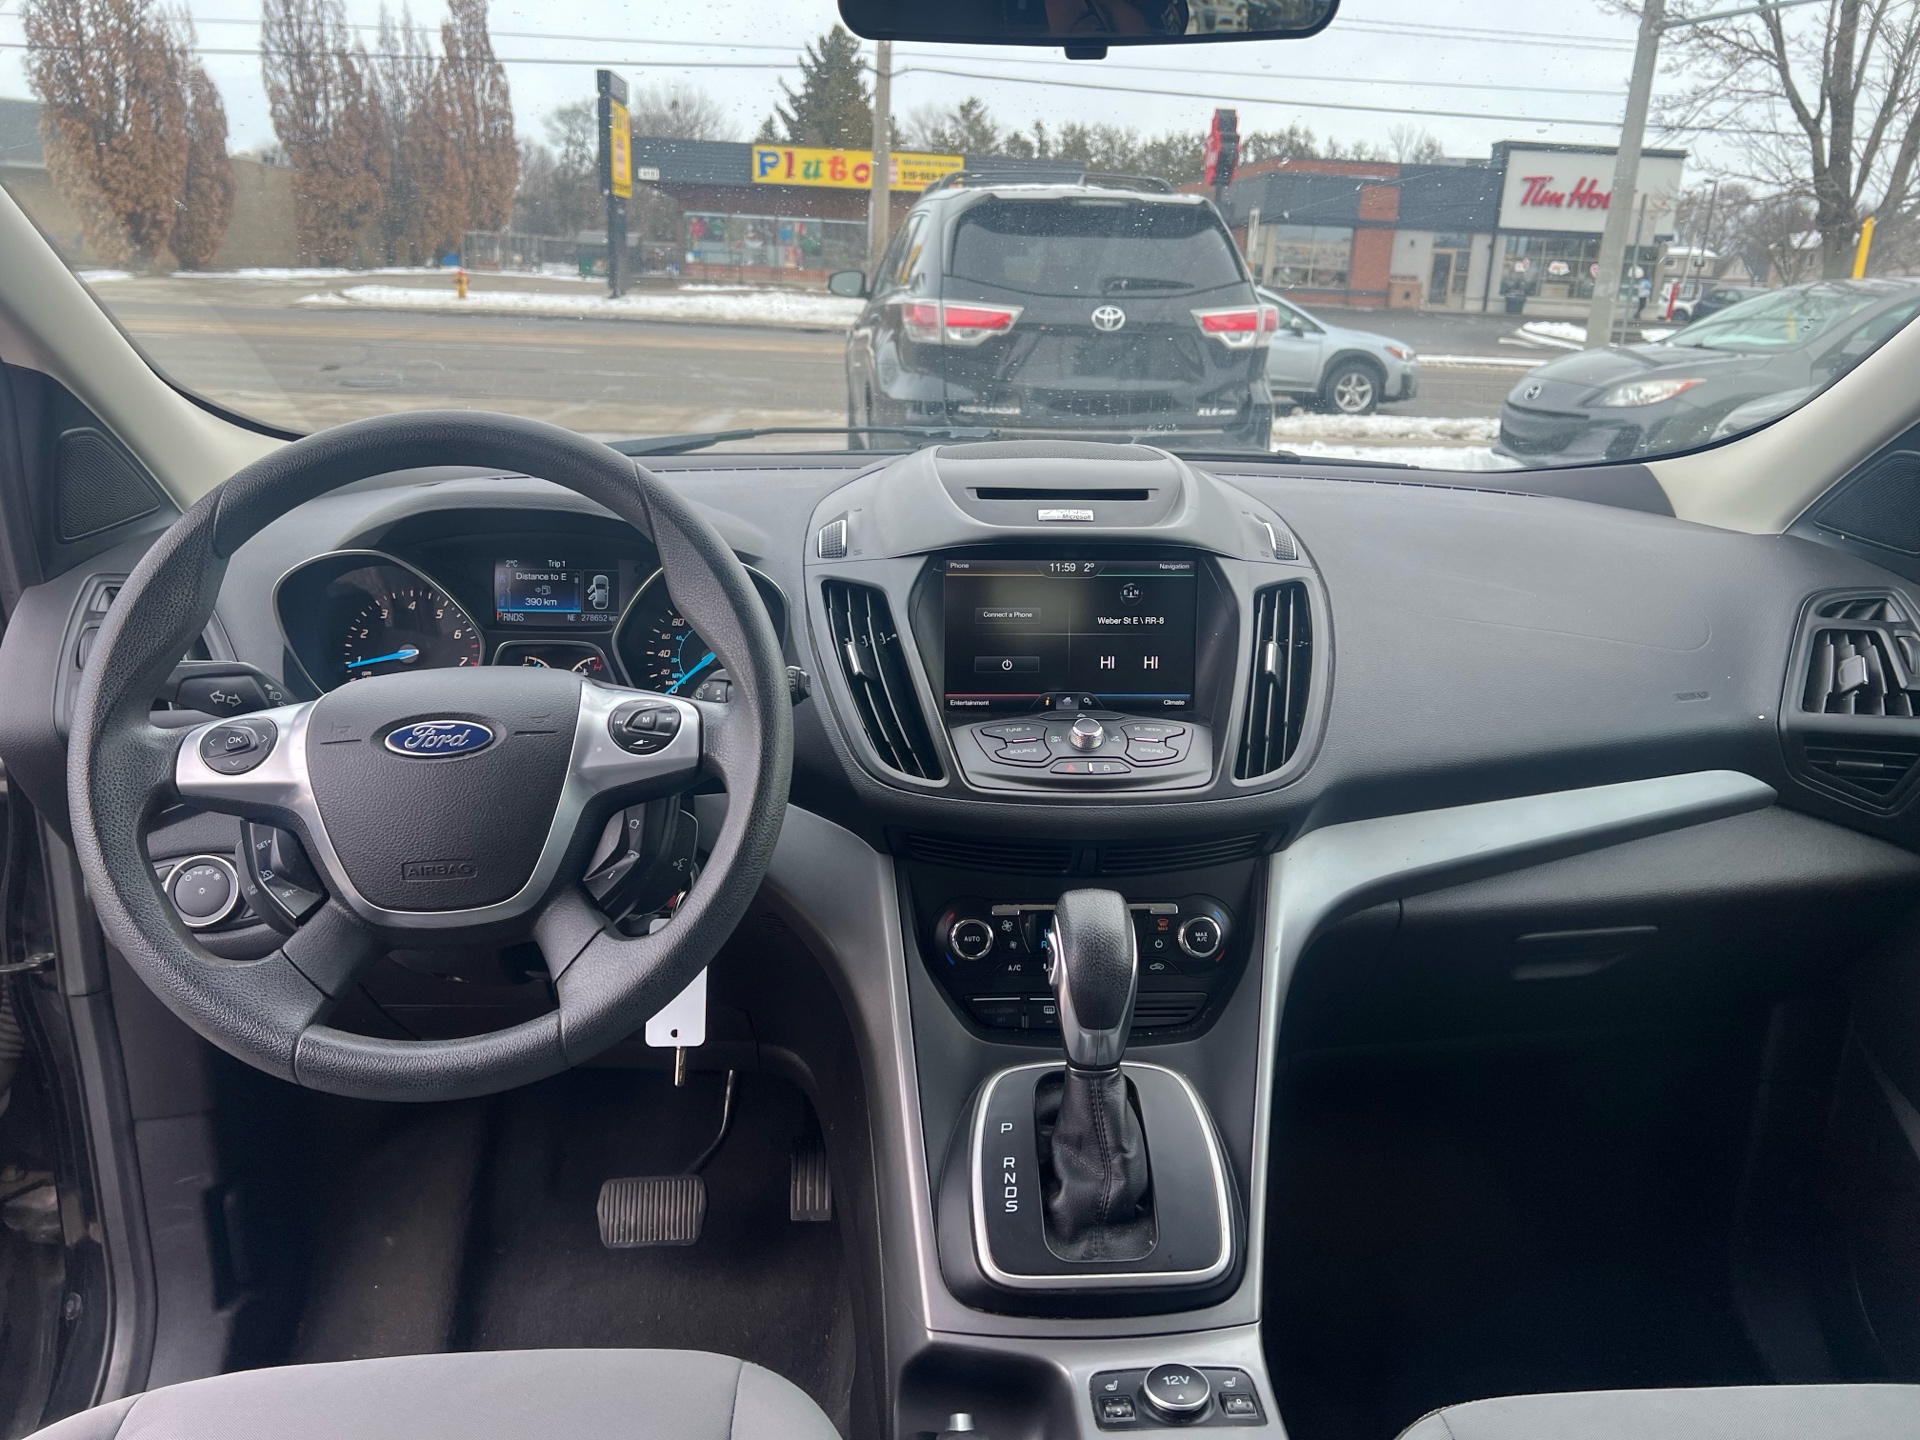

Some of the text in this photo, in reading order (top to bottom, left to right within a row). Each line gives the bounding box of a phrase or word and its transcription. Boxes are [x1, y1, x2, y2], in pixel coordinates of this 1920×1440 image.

[1520, 176, 1566, 208] Tim
[548, 560, 560, 568] Trip
[1050, 563, 1076, 572] 11:59
[1159, 563, 1190, 571] Navigation
[516, 572, 549, 580] Distance
[551, 572, 558, 580] to
[408, 601, 416, 610] 4
[525, 598, 557, 606] 390 km
[380, 609, 388, 618] 3
[436, 609, 444, 618] 5
[581, 614, 608, 622] 278652
[1014, 611, 1033, 619] Phone
[671, 618, 685, 626] 80
[1097, 617, 1122, 625] Weber
[1123, 617, 1132, 625] St
[1133, 617, 1139, 625] E
[1145, 617, 1165, 625] RR-8
[360, 629, 368, 638] 2
[453, 630, 461, 639] 6
[459, 657, 468, 666] 7
[1100, 656, 1159, 669] HI HI
[950, 699, 989, 707] Entertainment
[642, 716, 650, 724] M
[228, 736, 243, 744] OK
[404, 725, 471, 749] Ford
[406, 863, 473, 877] AIRBAG
[1001, 1123, 1013, 1134] P
[1003, 1157, 1015, 1169] R
[1004, 1172, 1016, 1184] N
[1005, 1186, 1018, 1198] D
[1005, 1200, 1018, 1212] S
[1163, 1375, 1190, 1386] 12V
